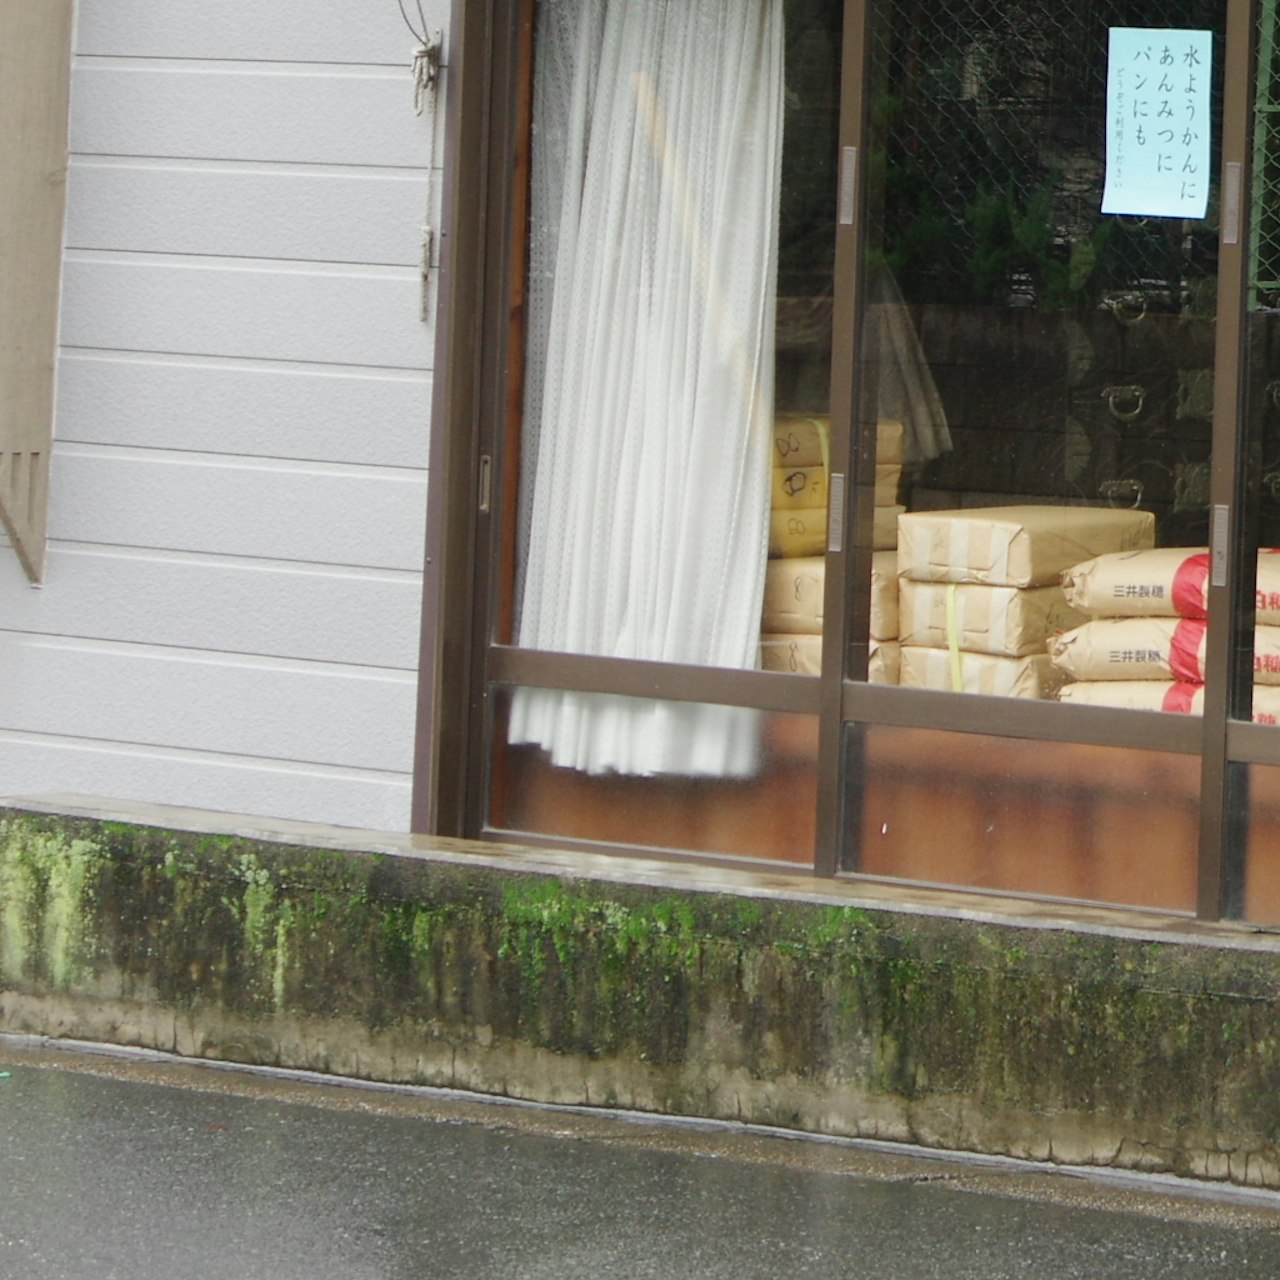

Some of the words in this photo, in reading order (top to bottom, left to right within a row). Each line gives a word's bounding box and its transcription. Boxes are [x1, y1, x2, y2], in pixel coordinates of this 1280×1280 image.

[1133, 45, 1151, 146] パンにも
[1157, 45, 1174, 172] あんみつに
[1180, 45, 1201, 200] 水ようかんに
